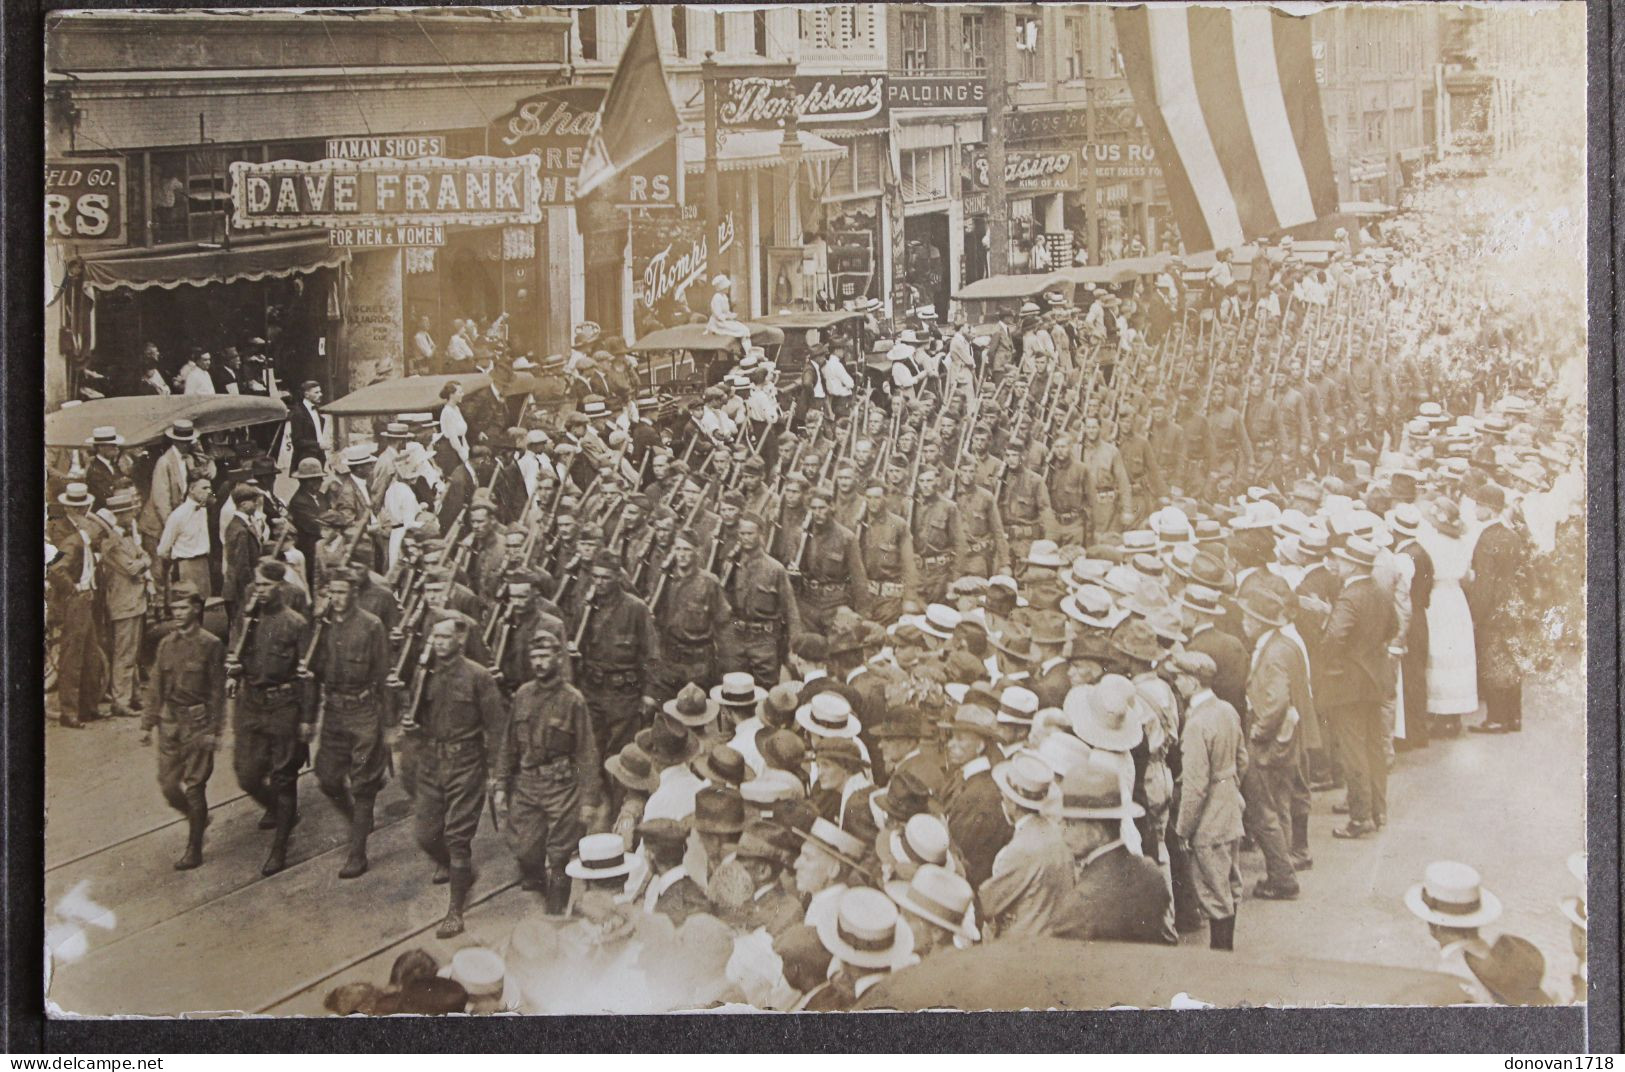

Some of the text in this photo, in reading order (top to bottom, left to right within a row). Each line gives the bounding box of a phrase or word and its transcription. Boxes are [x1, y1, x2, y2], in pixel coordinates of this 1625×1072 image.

[329, 138, 440, 158] HANAN SHOES
[247, 172, 520, 212] DAVE FRANK
[45, 193, 109, 236] RS
[681, 205, 698, 220] 1520
[330, 226, 443, 246] FOR MEN & WOMEN
[644, 210, 735, 308] Thompsn's
